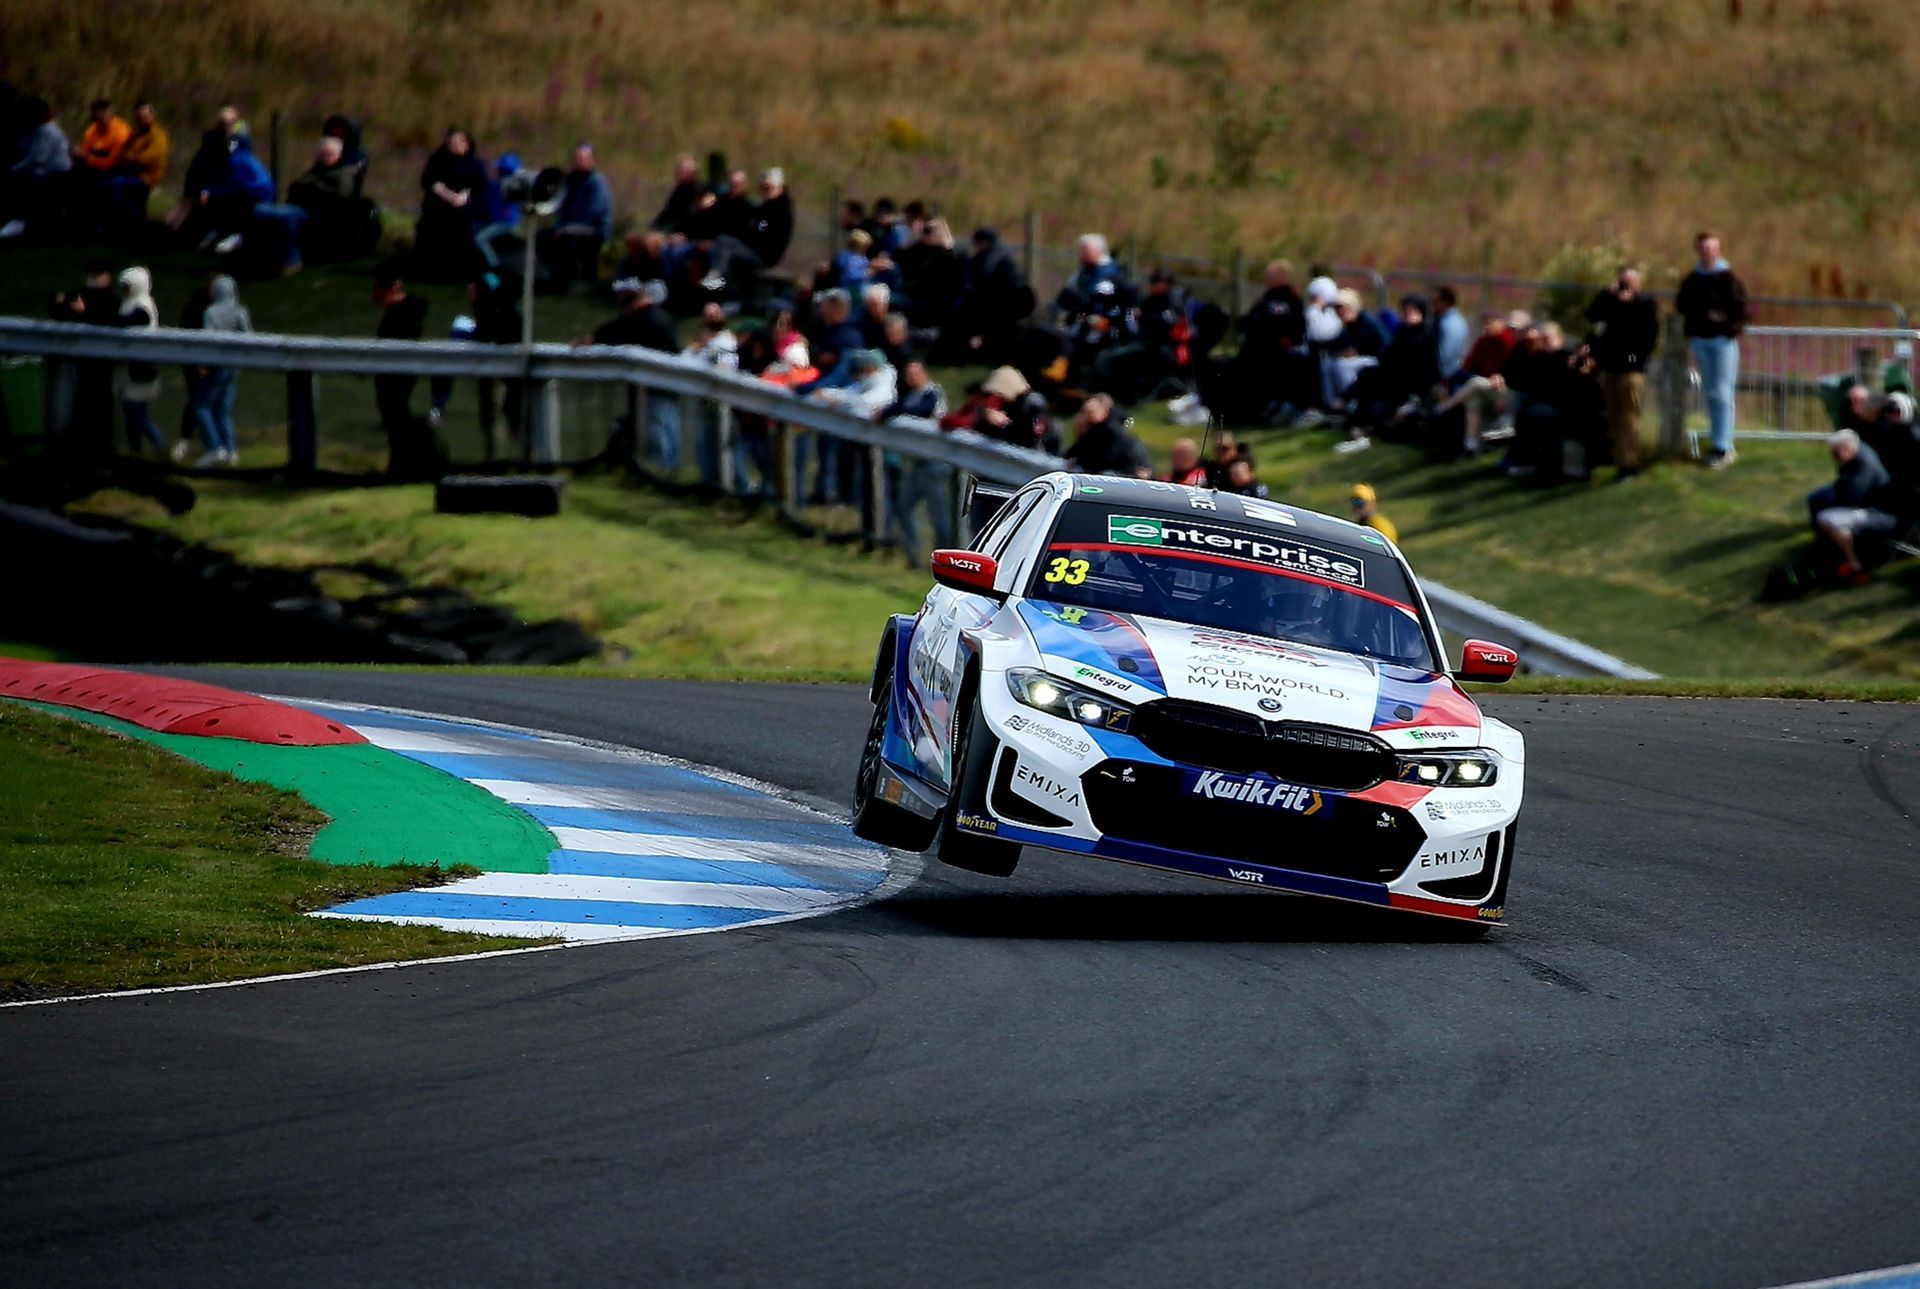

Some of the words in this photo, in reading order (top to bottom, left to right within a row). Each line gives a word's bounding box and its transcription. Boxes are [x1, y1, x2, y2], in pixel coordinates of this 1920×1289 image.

[1125, 522, 1359, 576] enterprise
[949, 556, 981, 573] WSR
[1044, 557, 1090, 585] 33
[1275, 558, 1359, 583] rent-a-car
[1480, 652, 1509, 663] WSR
[1077, 667, 1133, 691] Entegral
[1187, 664, 1254, 681] YOUR
[1259, 674, 1350, 701] WORLD.
[1225, 679, 1287, 698] BMW.
[1027, 721, 1074, 747] Midlands
[1074, 740, 1091, 753] 3D
[1409, 730, 1460, 740] Entegral
[1228, 867, 1264, 882] WSR
